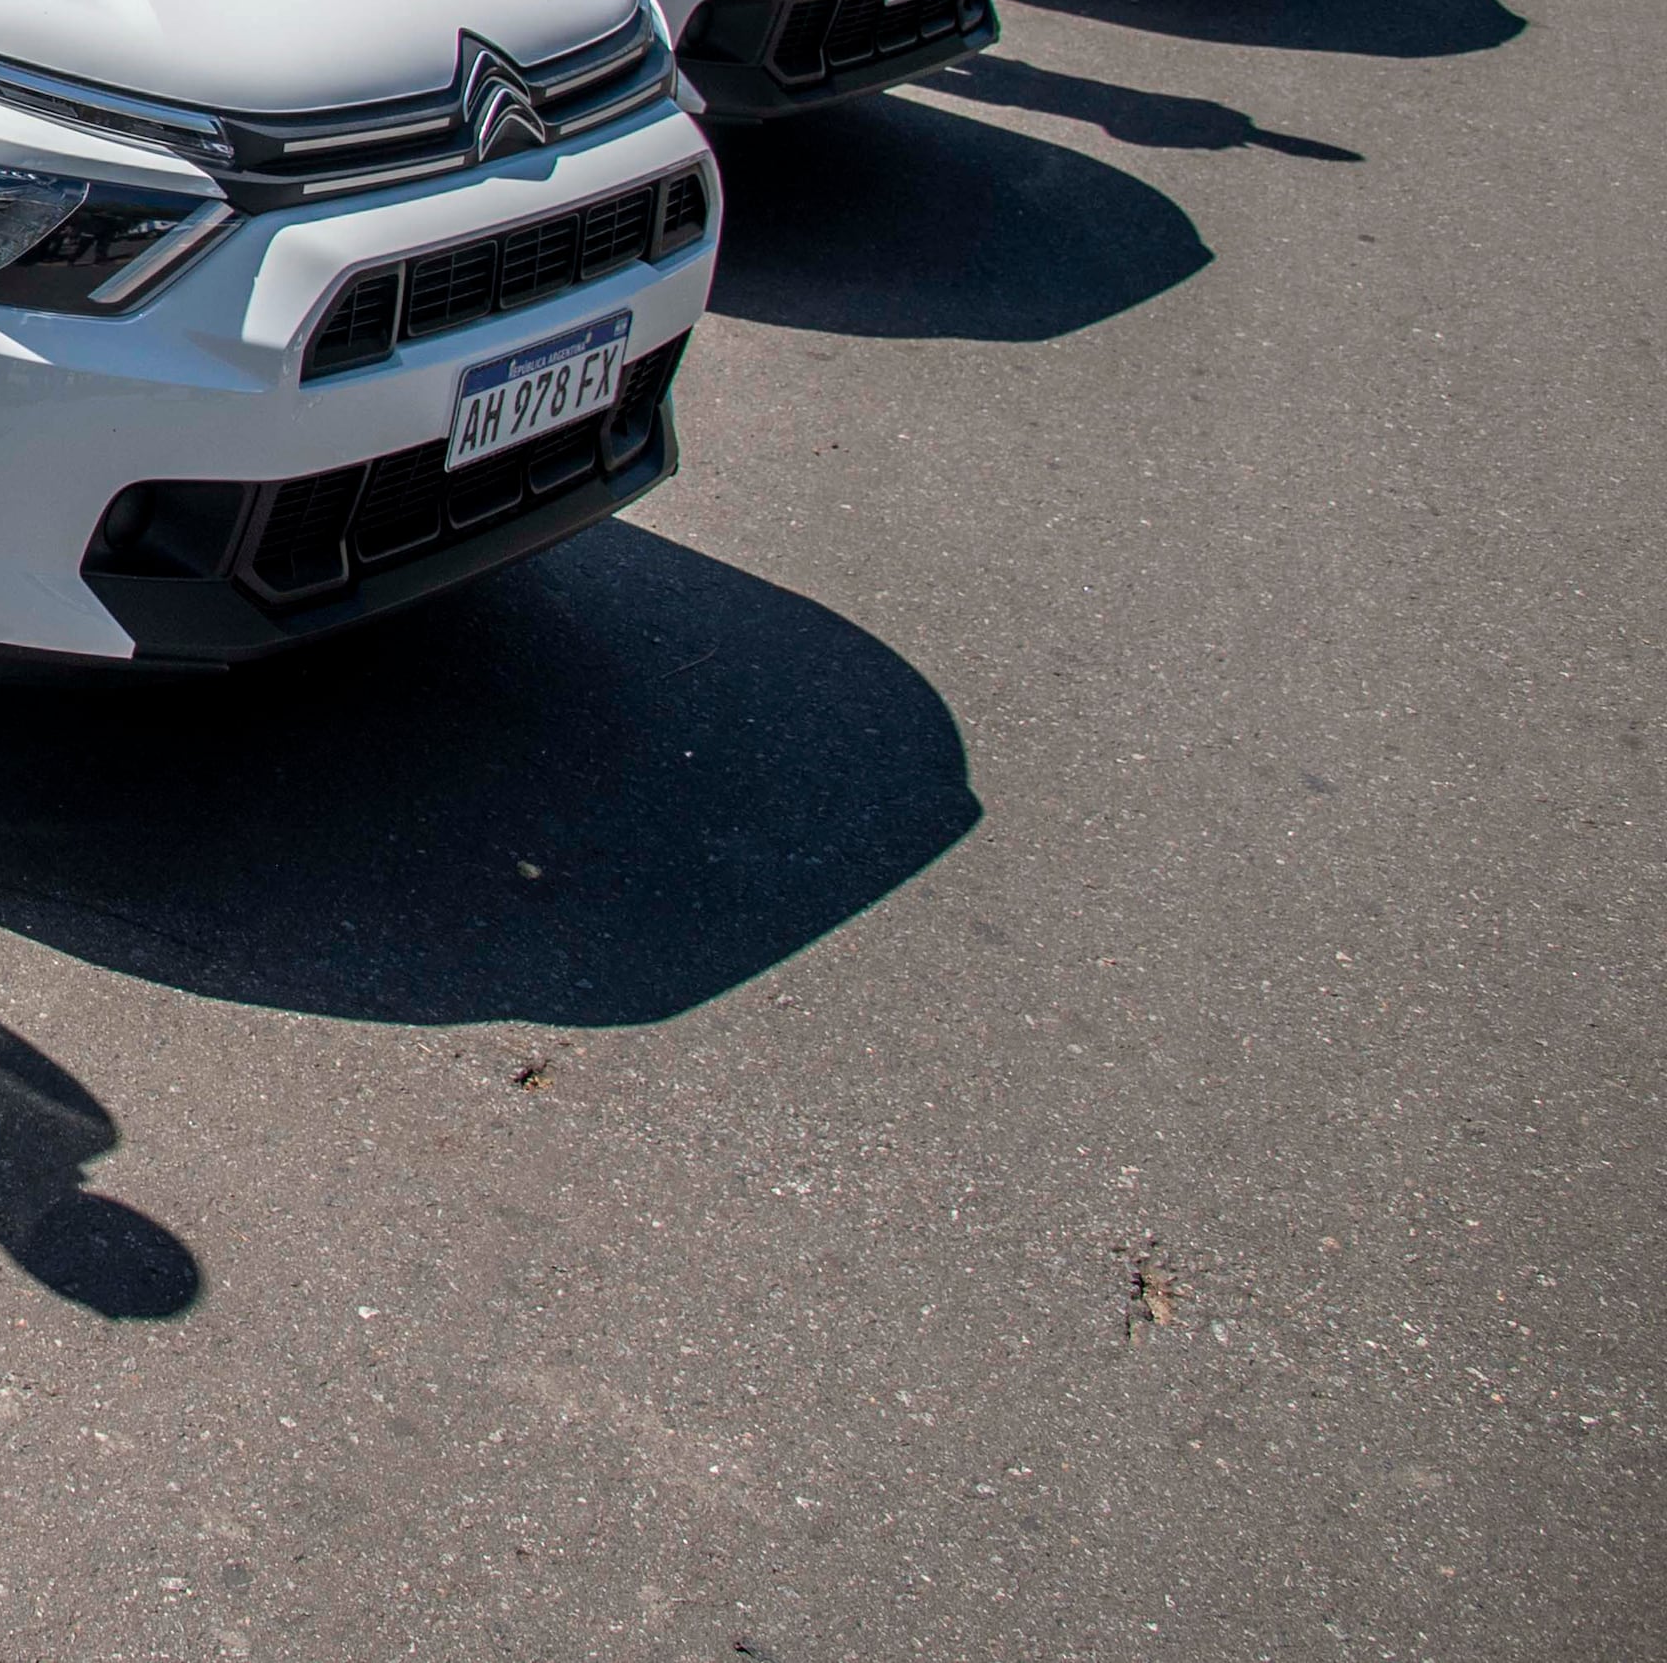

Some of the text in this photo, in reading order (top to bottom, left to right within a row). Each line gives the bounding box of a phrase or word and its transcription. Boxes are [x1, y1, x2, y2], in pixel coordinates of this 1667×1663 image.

[459, 344, 619, 455] AH 978 FX
